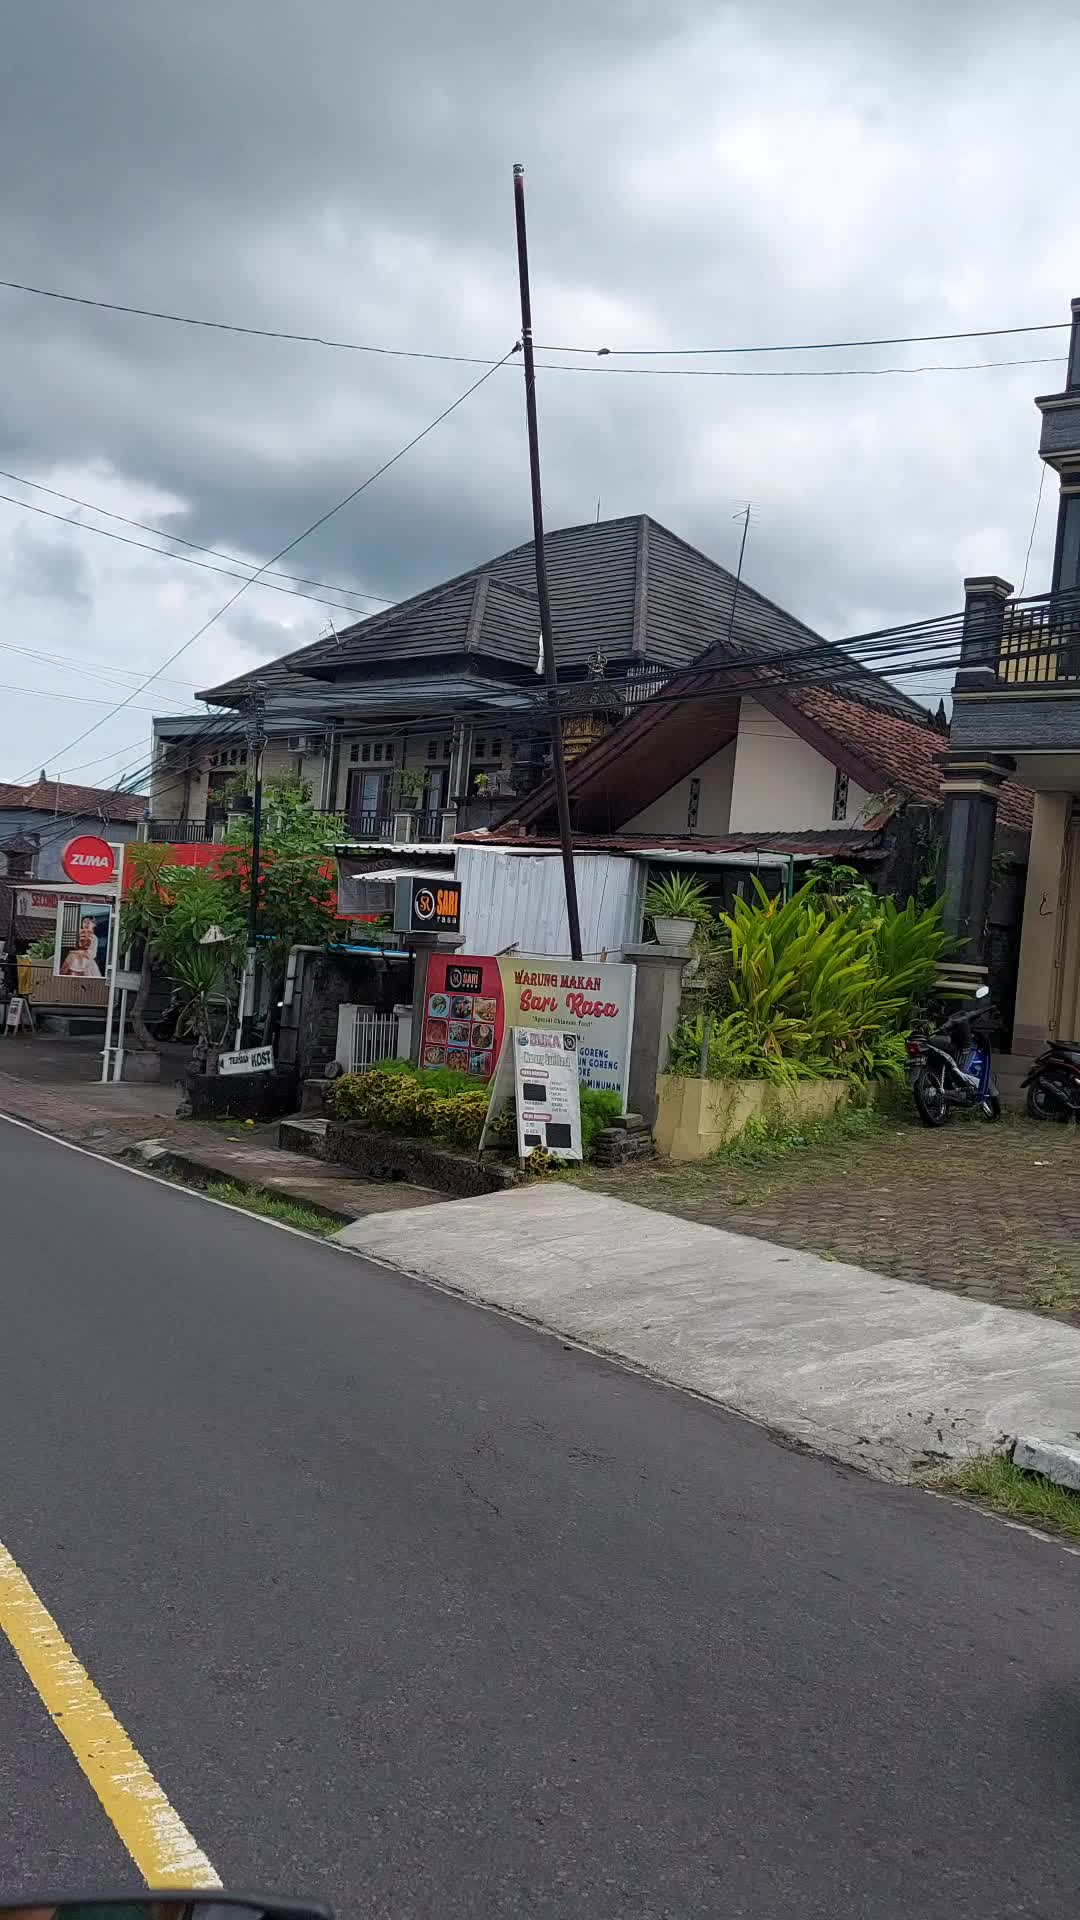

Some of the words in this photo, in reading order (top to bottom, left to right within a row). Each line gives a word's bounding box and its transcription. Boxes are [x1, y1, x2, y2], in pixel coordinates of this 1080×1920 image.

[70, 854, 109, 868] ZUMA
[514, 969, 558, 987] WARUNG
[560, 975, 601, 991] MAKAN
[520, 988, 558, 1012] Sari
[566, 992, 619, 1019] Rasa
[251, 1051, 271, 1067] KOST
[580, 1047, 608, 1059] GORENG
[589, 1059, 618, 1070] GORENG
[587, 1079, 621, 1091] MINUMAN
